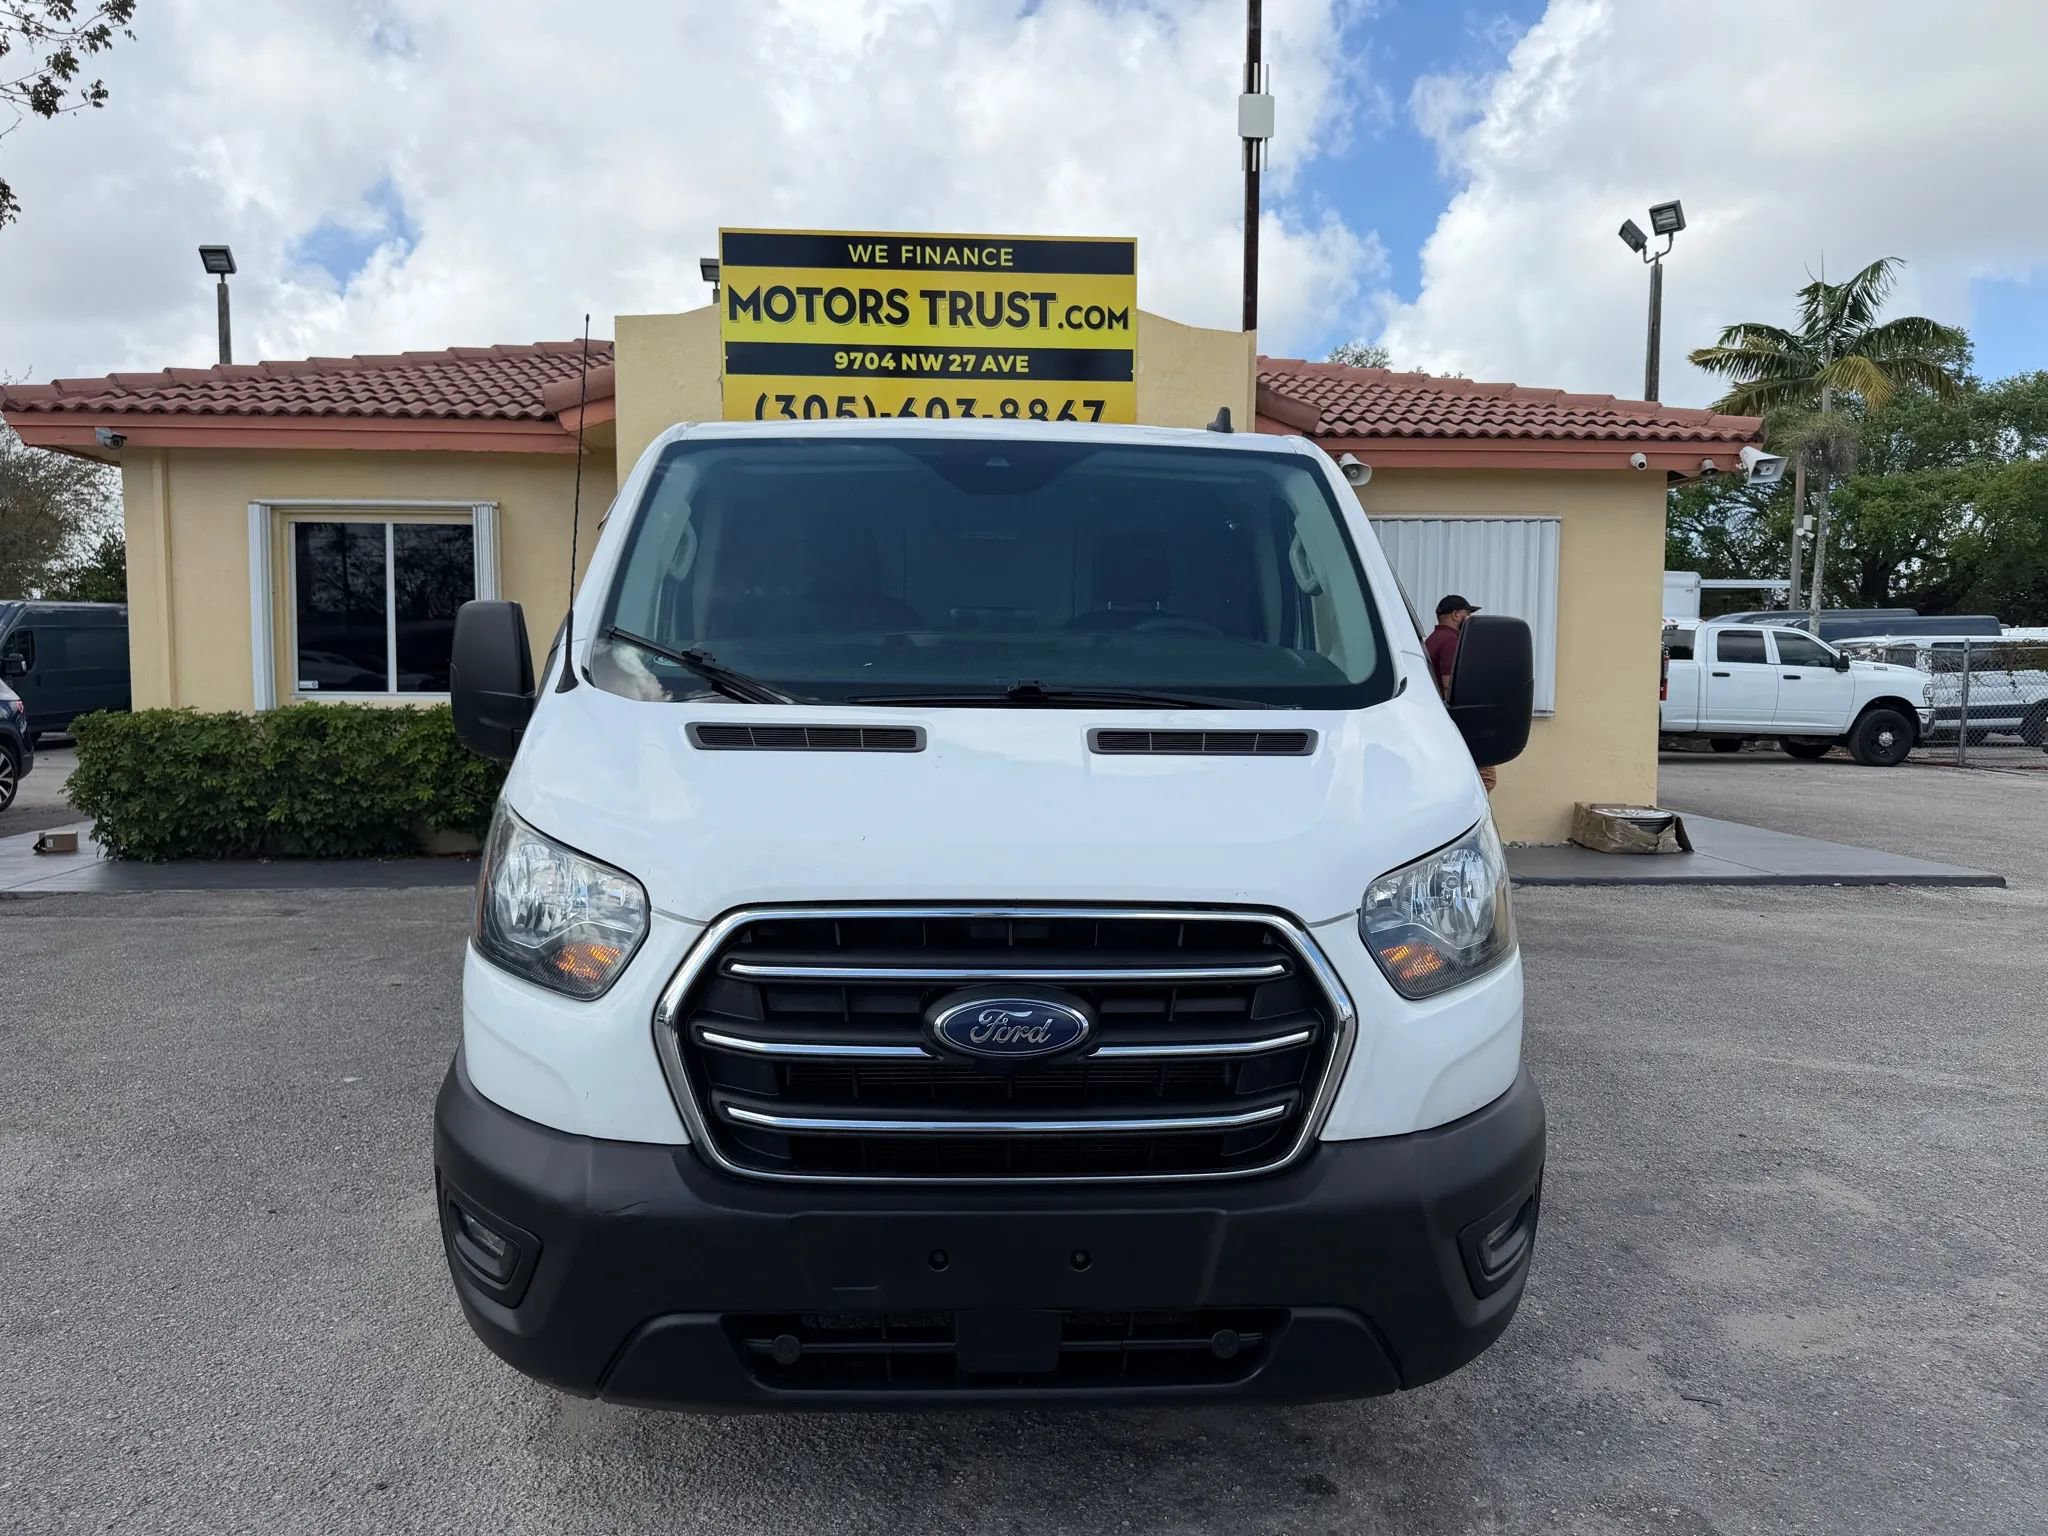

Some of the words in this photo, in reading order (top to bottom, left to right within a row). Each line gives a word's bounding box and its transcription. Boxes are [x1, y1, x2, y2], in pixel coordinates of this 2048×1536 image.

[848, 244, 889, 263] WE
[901, 245, 1014, 266] FINANCE
[728, 284, 911, 327] MOTORS
[919, 289, 1129, 330] TRUST.COM
[834, 351, 896, 370] 9704
[901, 353, 944, 371] NW
[948, 354, 976, 372] 27
[980, 355, 1030, 373] AVE
[970, 1009, 1053, 1043] Ford
